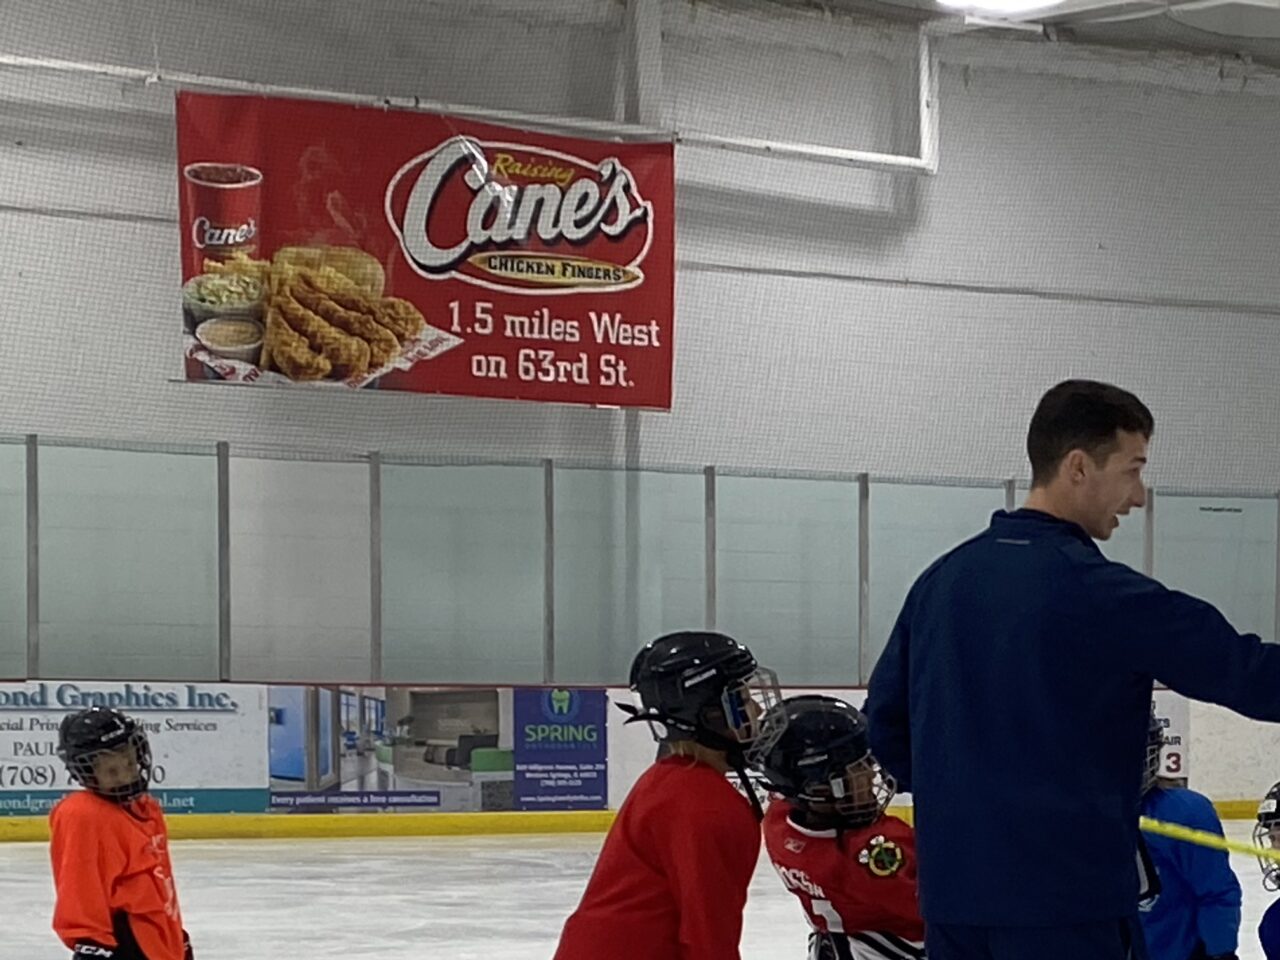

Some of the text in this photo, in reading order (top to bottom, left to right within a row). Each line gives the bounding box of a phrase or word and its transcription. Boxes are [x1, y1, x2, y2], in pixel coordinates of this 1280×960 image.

[491, 152, 577, 186] Raising
[487, 255, 624, 282] CHICKEN FINGERS
[449, 300, 661, 347] 1.5 miles West
[471, 348, 635, 388] on 63rd St.
[55, 683, 180, 708] Graphics
[186, 685, 239, 708] Inc.
[164, 718, 218, 731] Services
[523, 724, 598, 742] SPRING
[1165, 752, 1182, 773] 3
[0, 764, 56, 787] (708)
